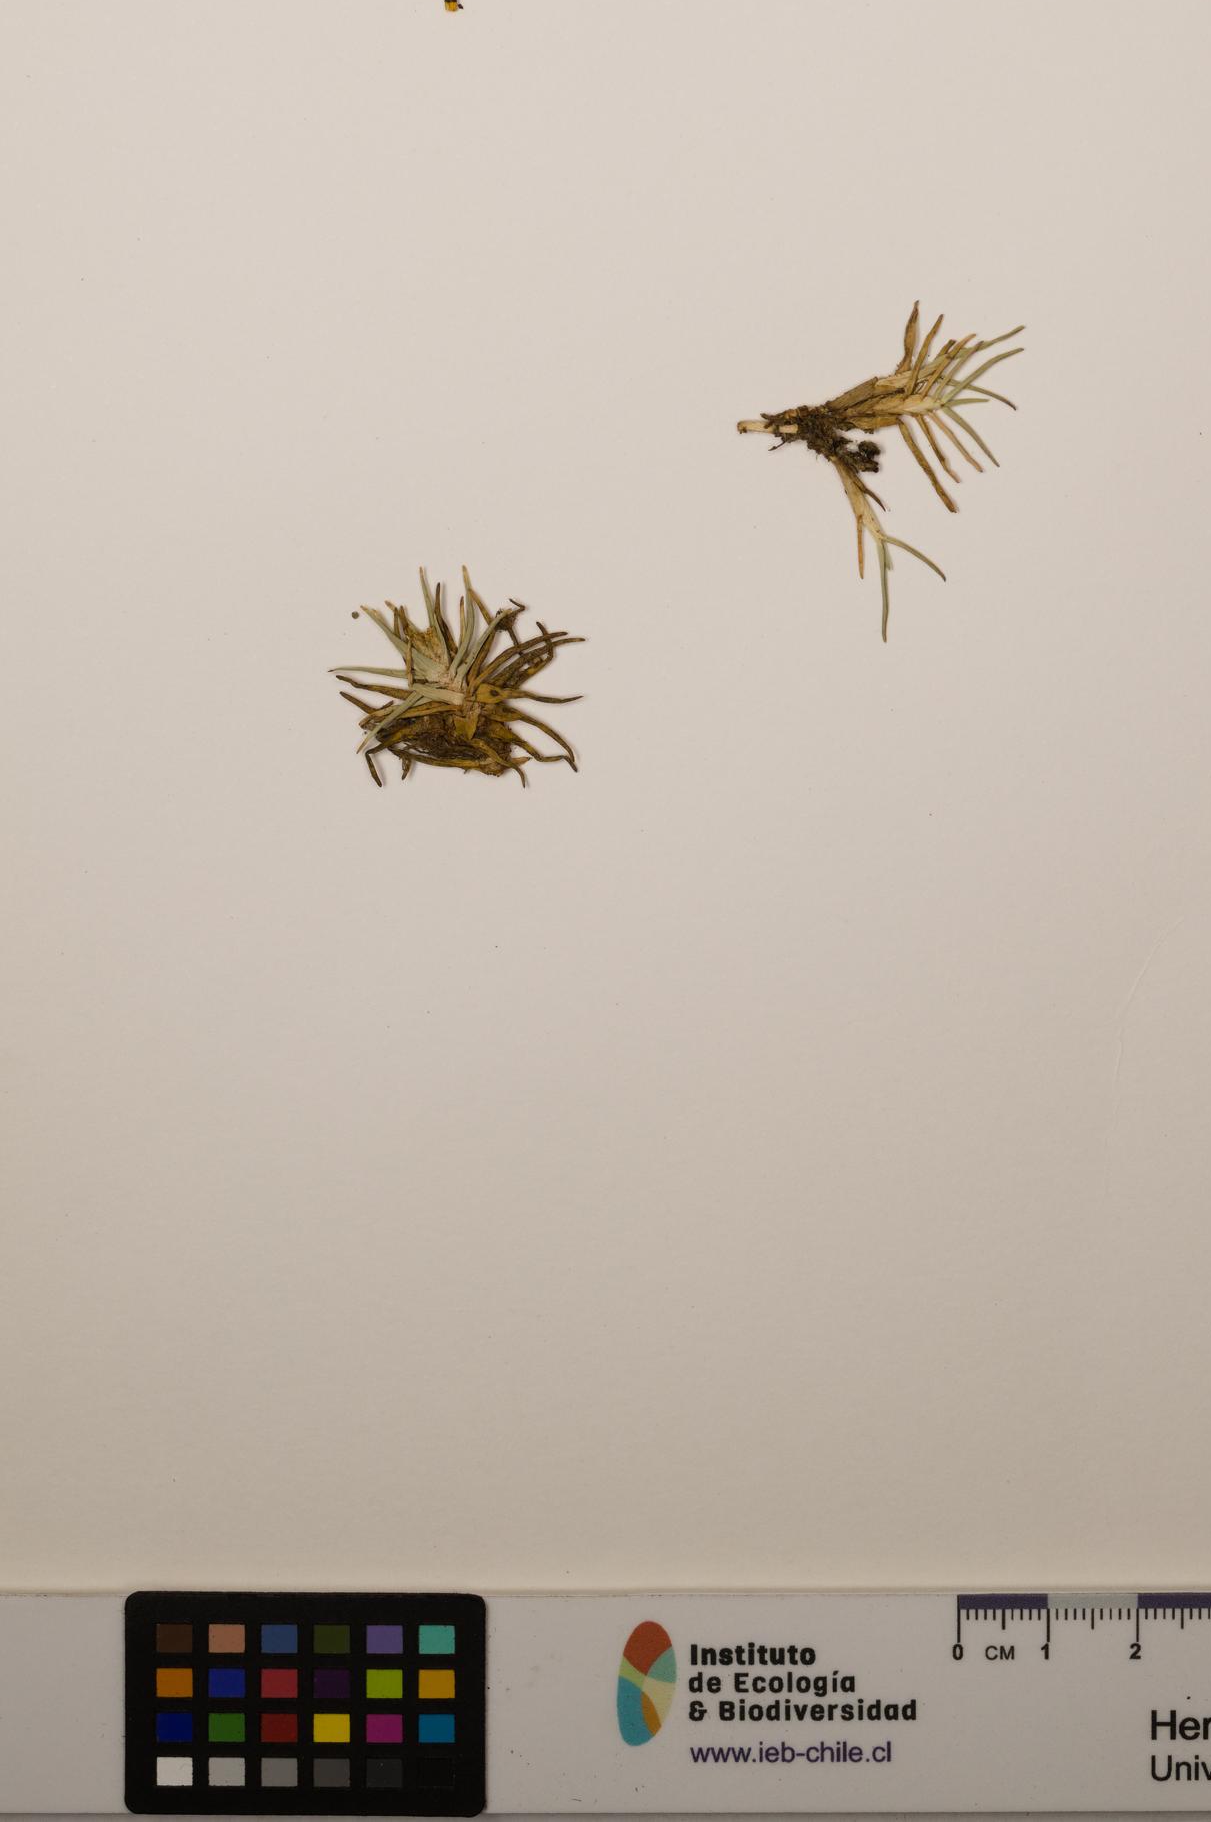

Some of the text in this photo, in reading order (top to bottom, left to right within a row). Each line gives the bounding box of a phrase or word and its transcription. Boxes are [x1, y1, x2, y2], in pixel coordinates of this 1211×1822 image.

[690, 1641, 817, 1667] Instituto
[951, 1641, 964, 1661] 0
[984, 1644, 1015, 1661] CM
[1040, 1641, 1050, 1661] 1
[1128, 1641, 1142, 1661] 2
[688, 1670, 856, 1698] de Ecología
[688, 1698, 917, 1722] & Biodiversidad
[689, 1740, 892, 1764] www.ieb-chile.cl
